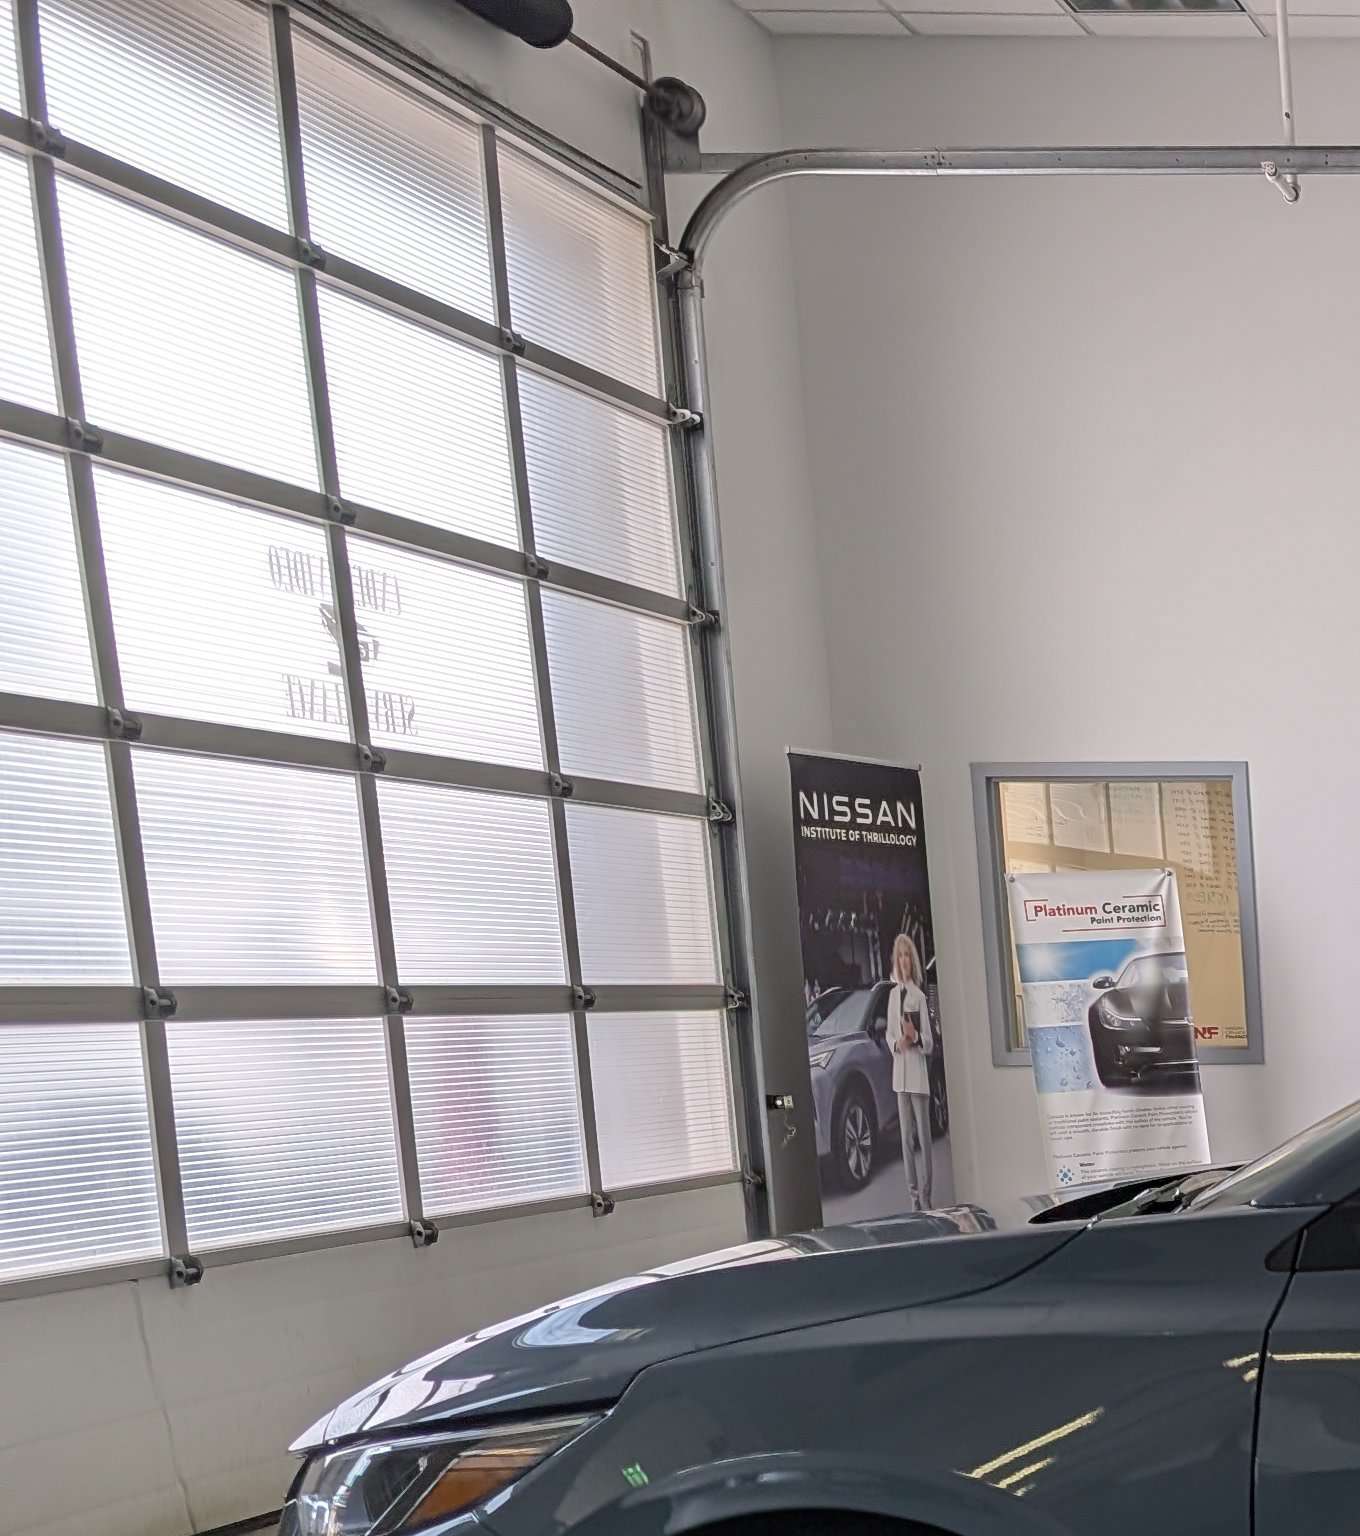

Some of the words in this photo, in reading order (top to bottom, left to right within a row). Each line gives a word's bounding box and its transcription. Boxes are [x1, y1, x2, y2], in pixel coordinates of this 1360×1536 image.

[799, 789, 917, 830] NISSAN
[801, 826, 848, 841] INSTITUTE
[848, 830, 861, 841] OF
[862, 831, 917, 847] THRILLOLOGY
[1033, 904, 1098, 917] Platinum
[1101, 900, 1161, 914] Ceramic
[1116, 914, 1162, 924] Protection
